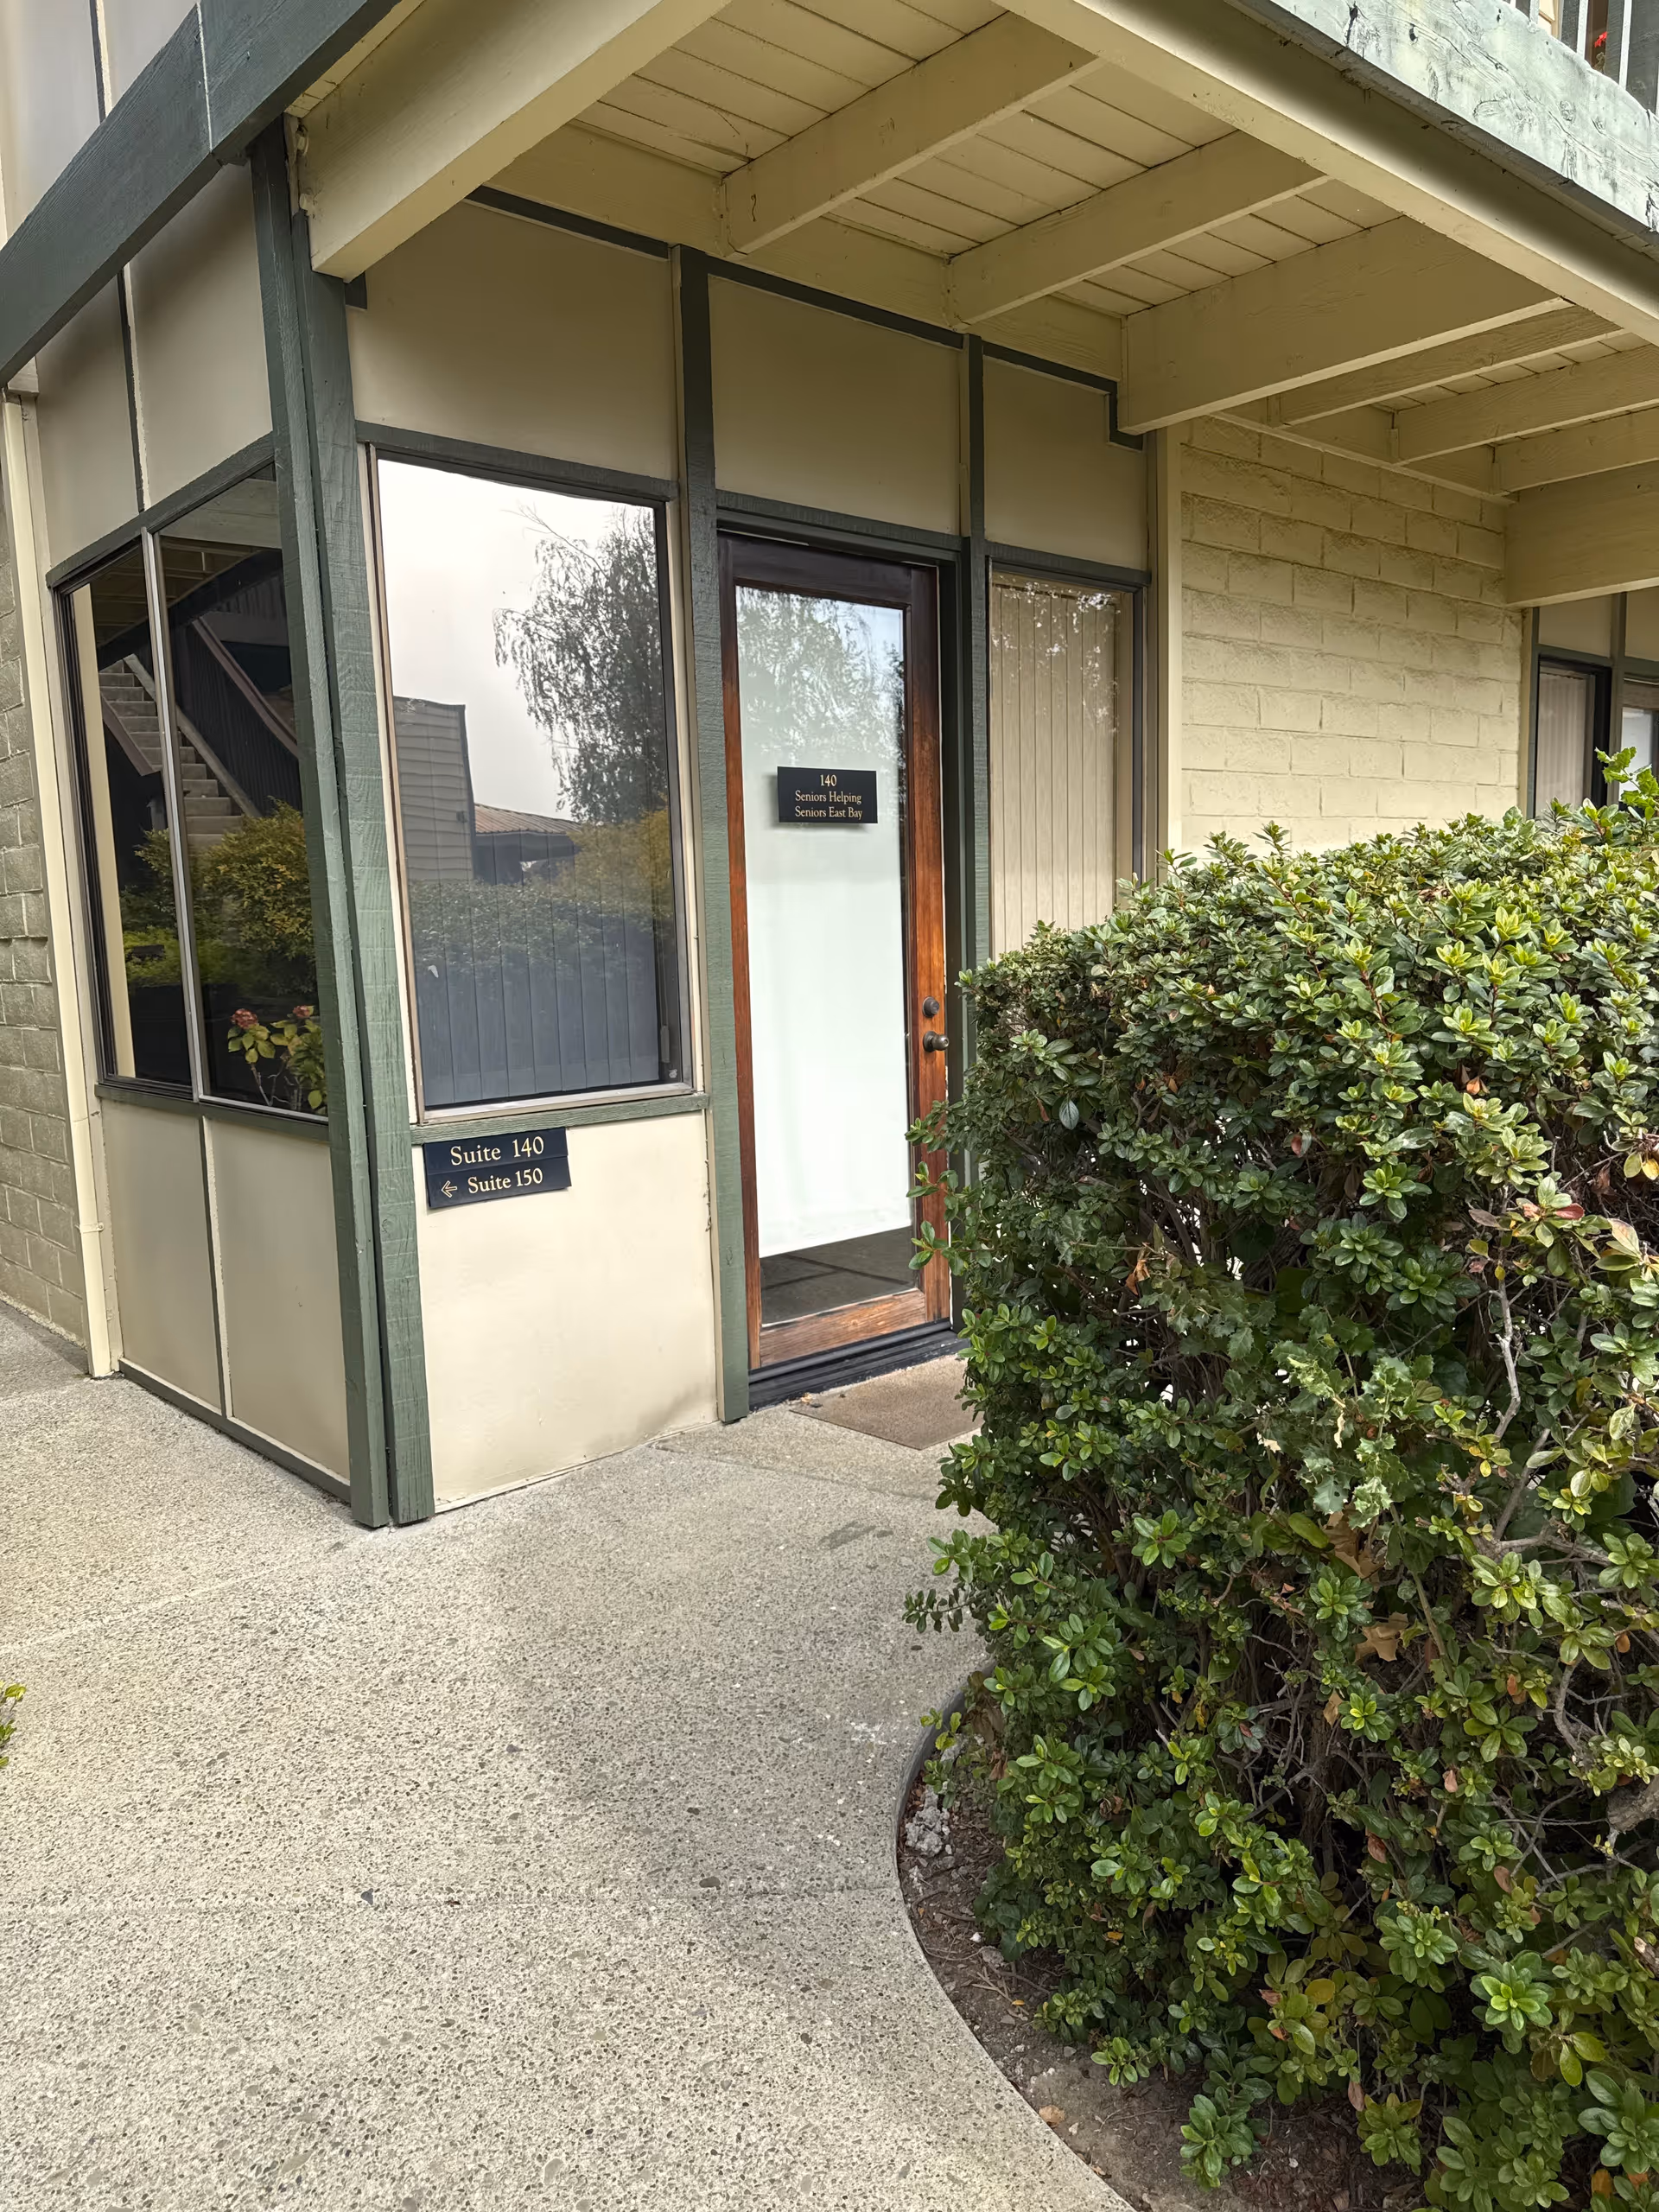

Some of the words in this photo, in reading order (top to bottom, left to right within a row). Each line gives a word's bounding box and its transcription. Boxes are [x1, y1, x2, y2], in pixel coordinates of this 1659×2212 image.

[820, 774, 837, 787] 140
[795, 790, 826, 802] Seniors
[829, 791, 861, 804] Helping
[795, 806, 826, 817] Seniors
[829, 807, 846, 818] East
[848, 807, 862, 820] Bay
[450, 1145, 501, 1166] Suite
[512, 1136, 544, 1157] 140
[467, 1175, 512, 1194] Suite
[515, 1167, 543, 1187] 150
